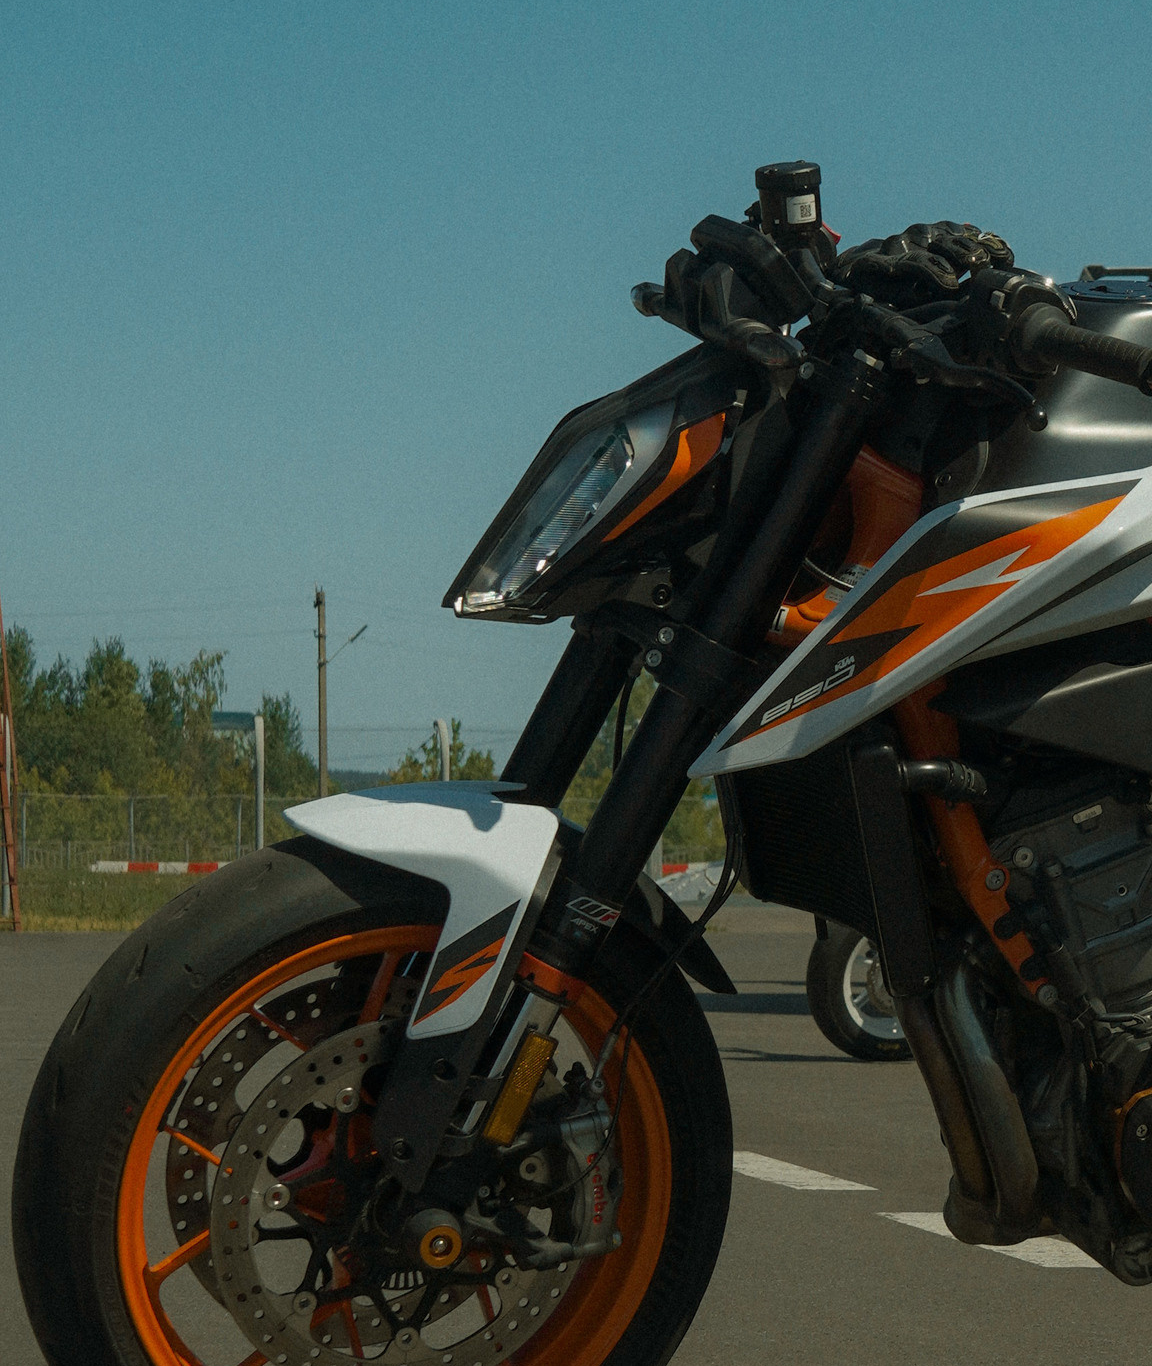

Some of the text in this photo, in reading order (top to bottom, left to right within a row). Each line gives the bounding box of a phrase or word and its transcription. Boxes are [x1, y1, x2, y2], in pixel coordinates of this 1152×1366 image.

[834, 655, 856, 672] KTM
[760, 665, 856, 726] 890
[570, 917, 599, 934] APEX
